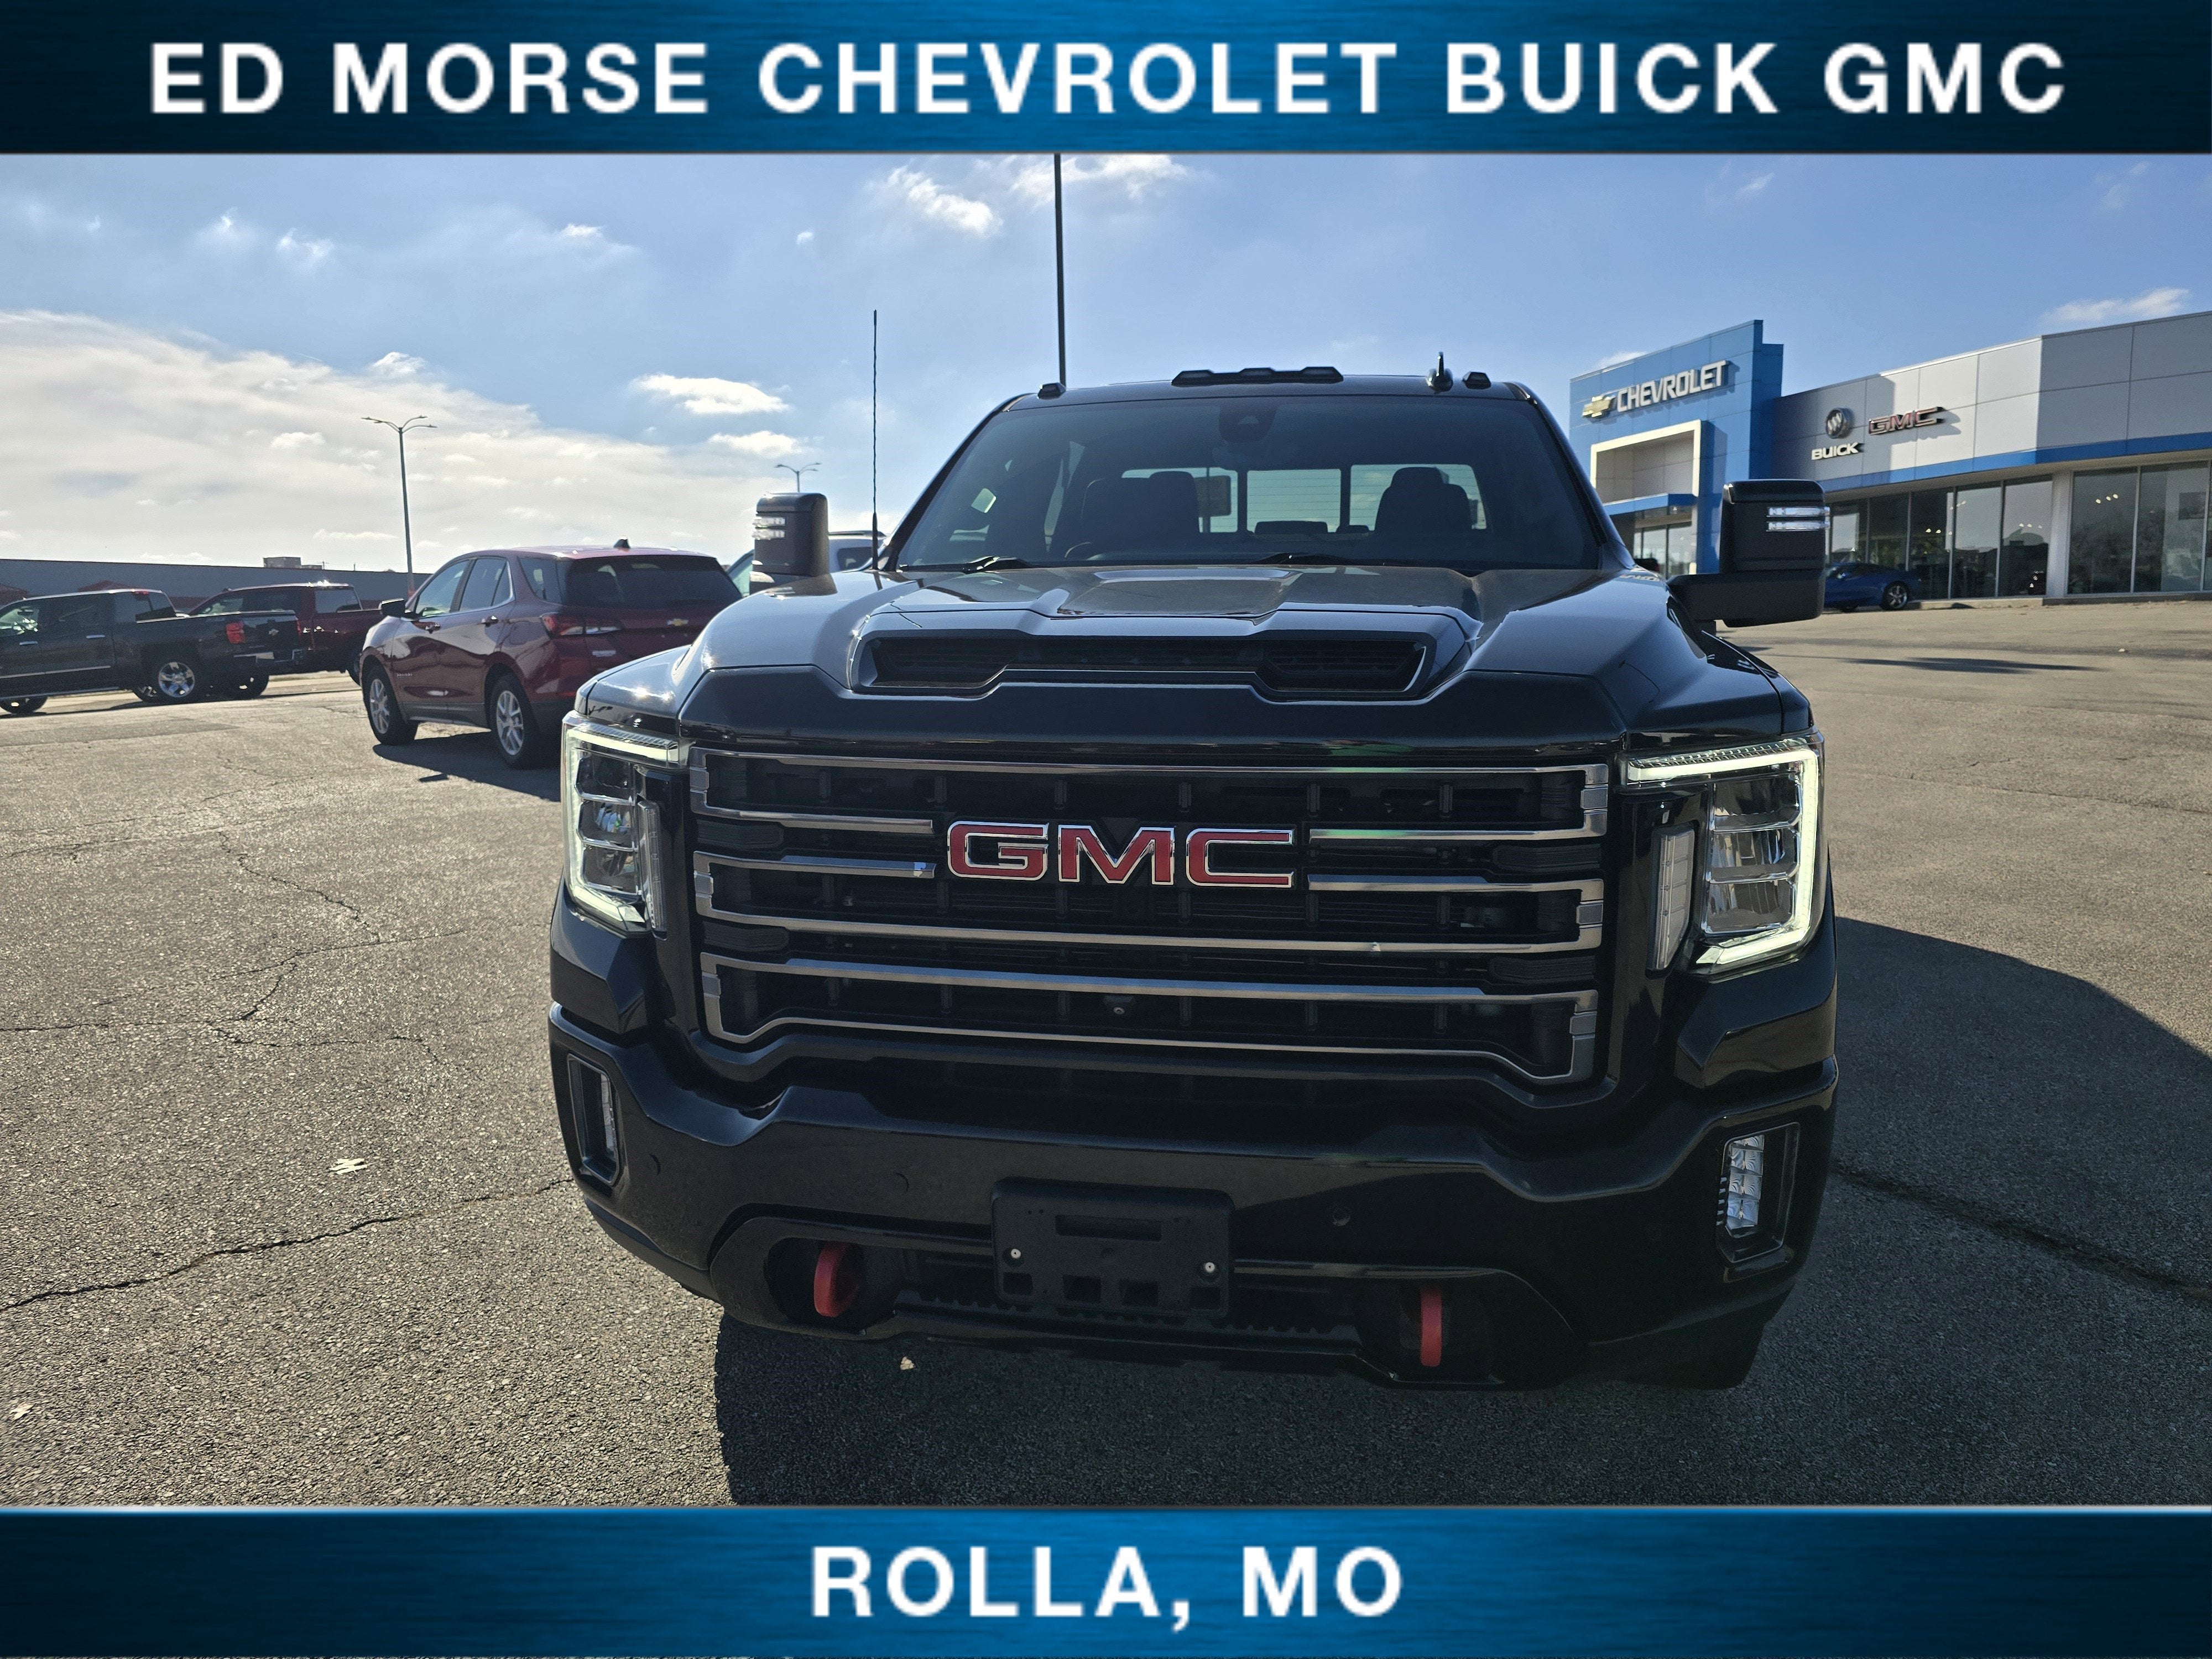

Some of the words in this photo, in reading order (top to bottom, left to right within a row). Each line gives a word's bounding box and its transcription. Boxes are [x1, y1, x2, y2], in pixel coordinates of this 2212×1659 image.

[1617, 360, 1728, 413] CHEVROLET
[1869, 406, 1940, 435] GMC
[1811, 442, 1859, 460] BUICK
[947, 821, 1294, 888] GMC
